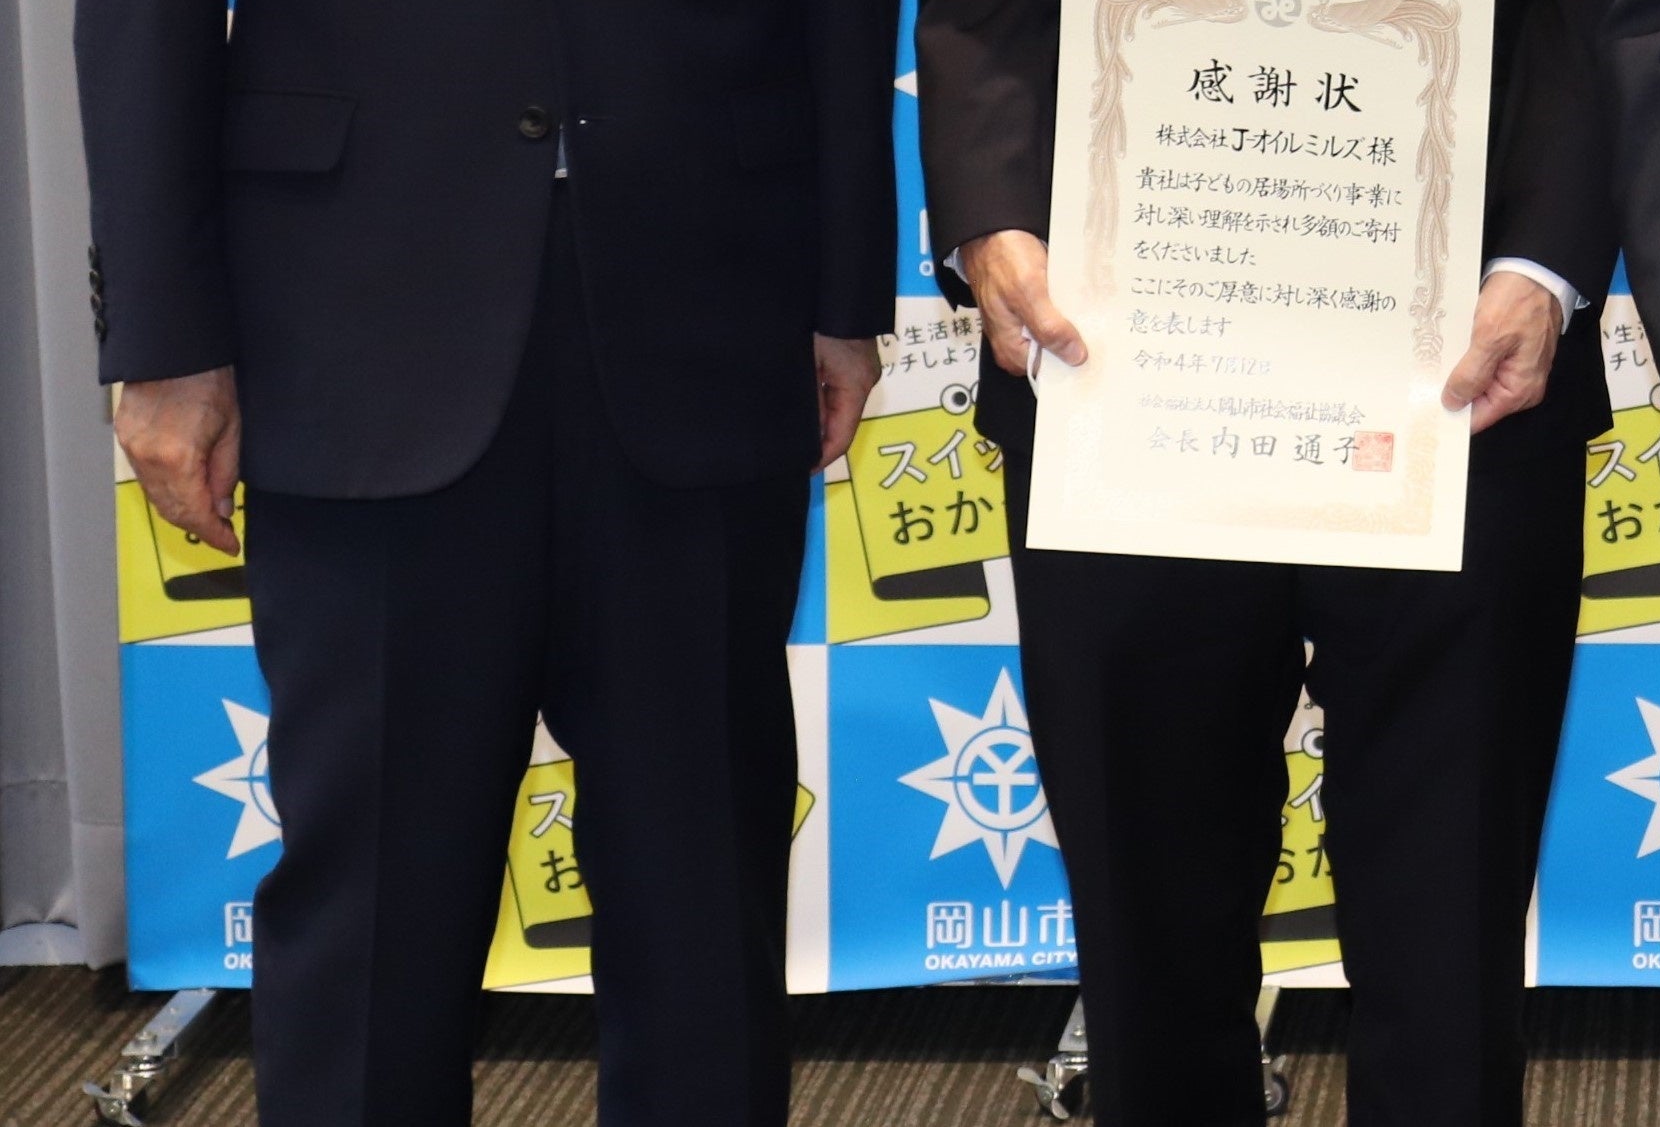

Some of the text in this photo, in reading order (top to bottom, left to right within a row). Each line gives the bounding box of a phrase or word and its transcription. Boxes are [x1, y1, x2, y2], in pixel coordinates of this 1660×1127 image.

[1187, 58, 1363, 113] 感謝状
[1136, 166, 1402, 207] 貴社は子どもの居場所づくり事業に
[1133, 203, 1402, 243] 対し深い理解を示され多額のご寄付
[1132, 240, 1256, 266] をくださいました
[1127, 309, 1233, 338] 意を表します
[926, 899, 1075, 949] 岡山市
[925, 953, 1025, 970] OKAYAMA
